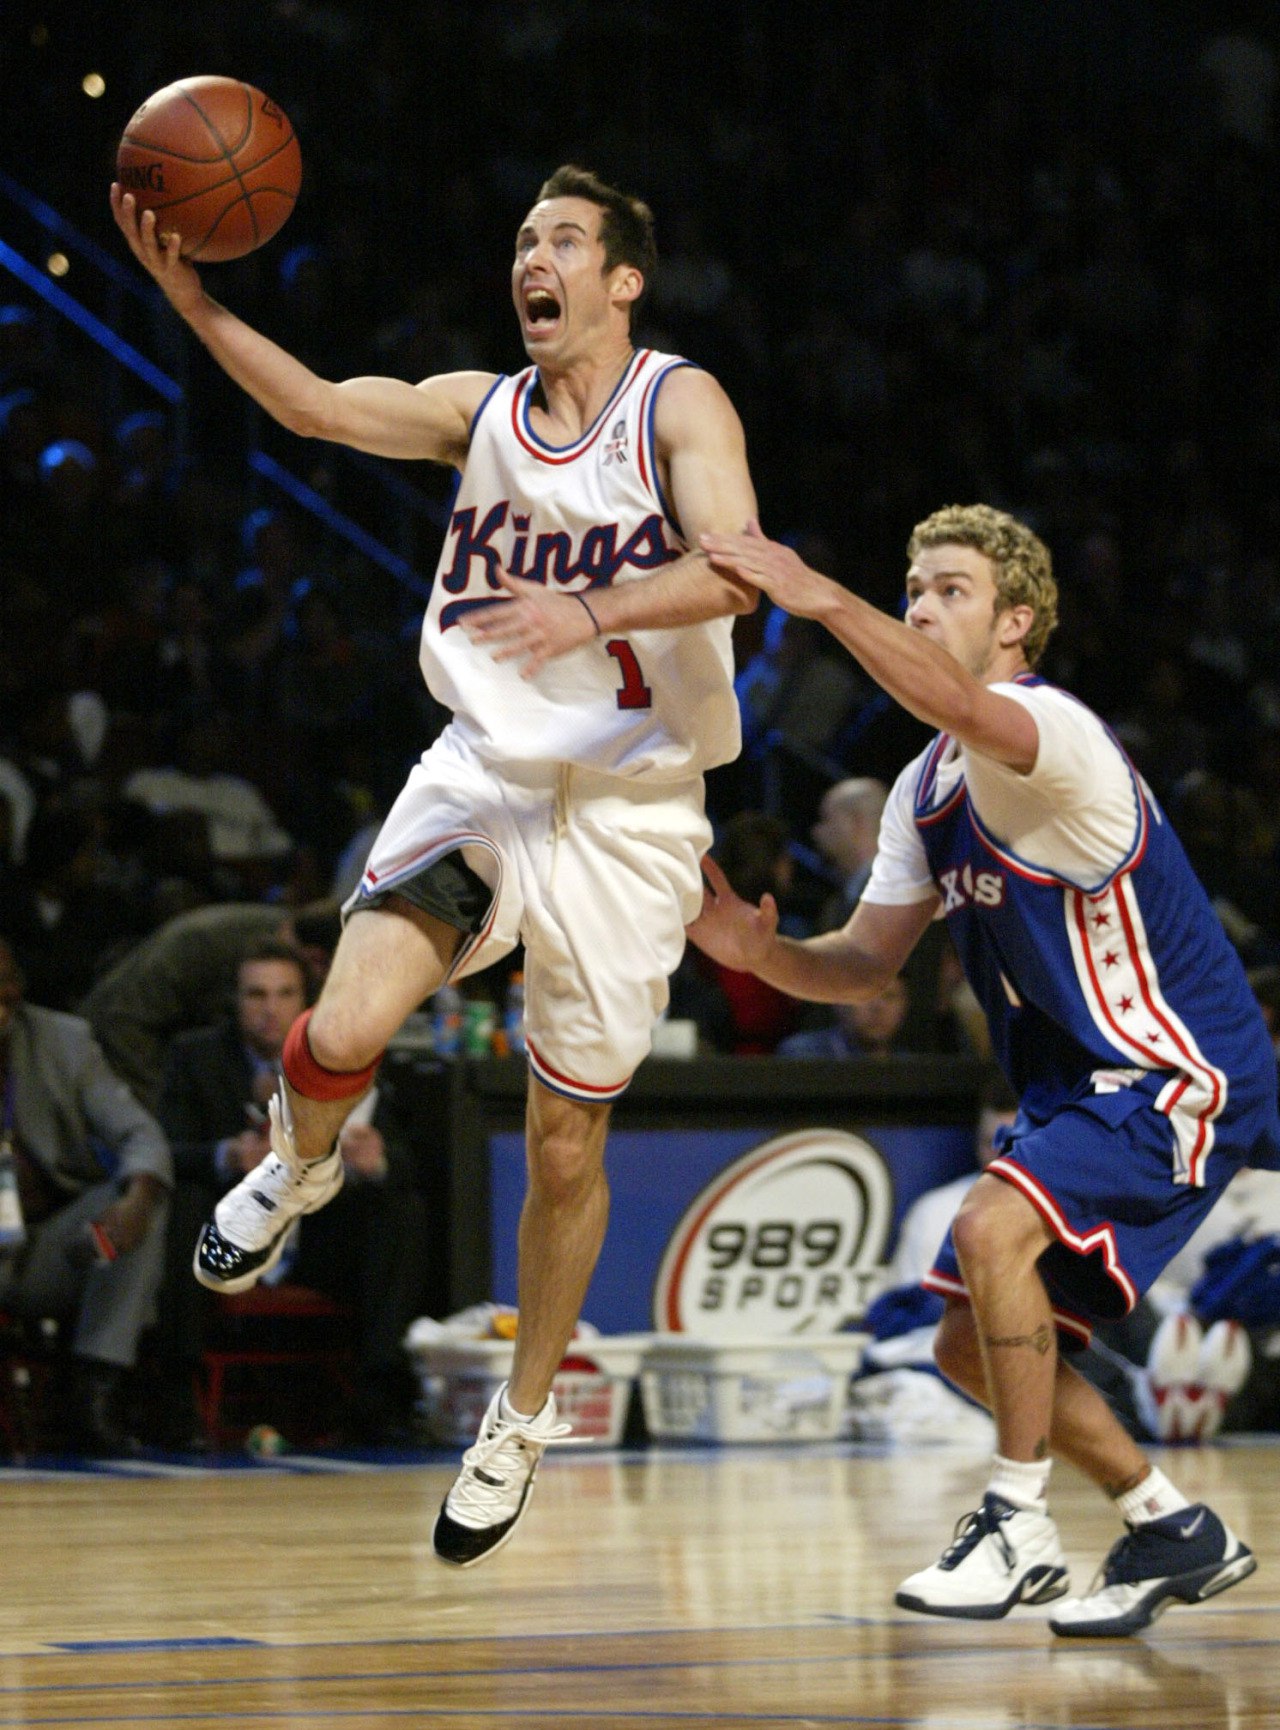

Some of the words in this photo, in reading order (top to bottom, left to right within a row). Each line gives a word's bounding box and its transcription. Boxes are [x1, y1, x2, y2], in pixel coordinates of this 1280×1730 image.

[441, 499, 684, 597] Kings
[605, 638, 652, 711] 1
[708, 1219, 842, 1270] 989
